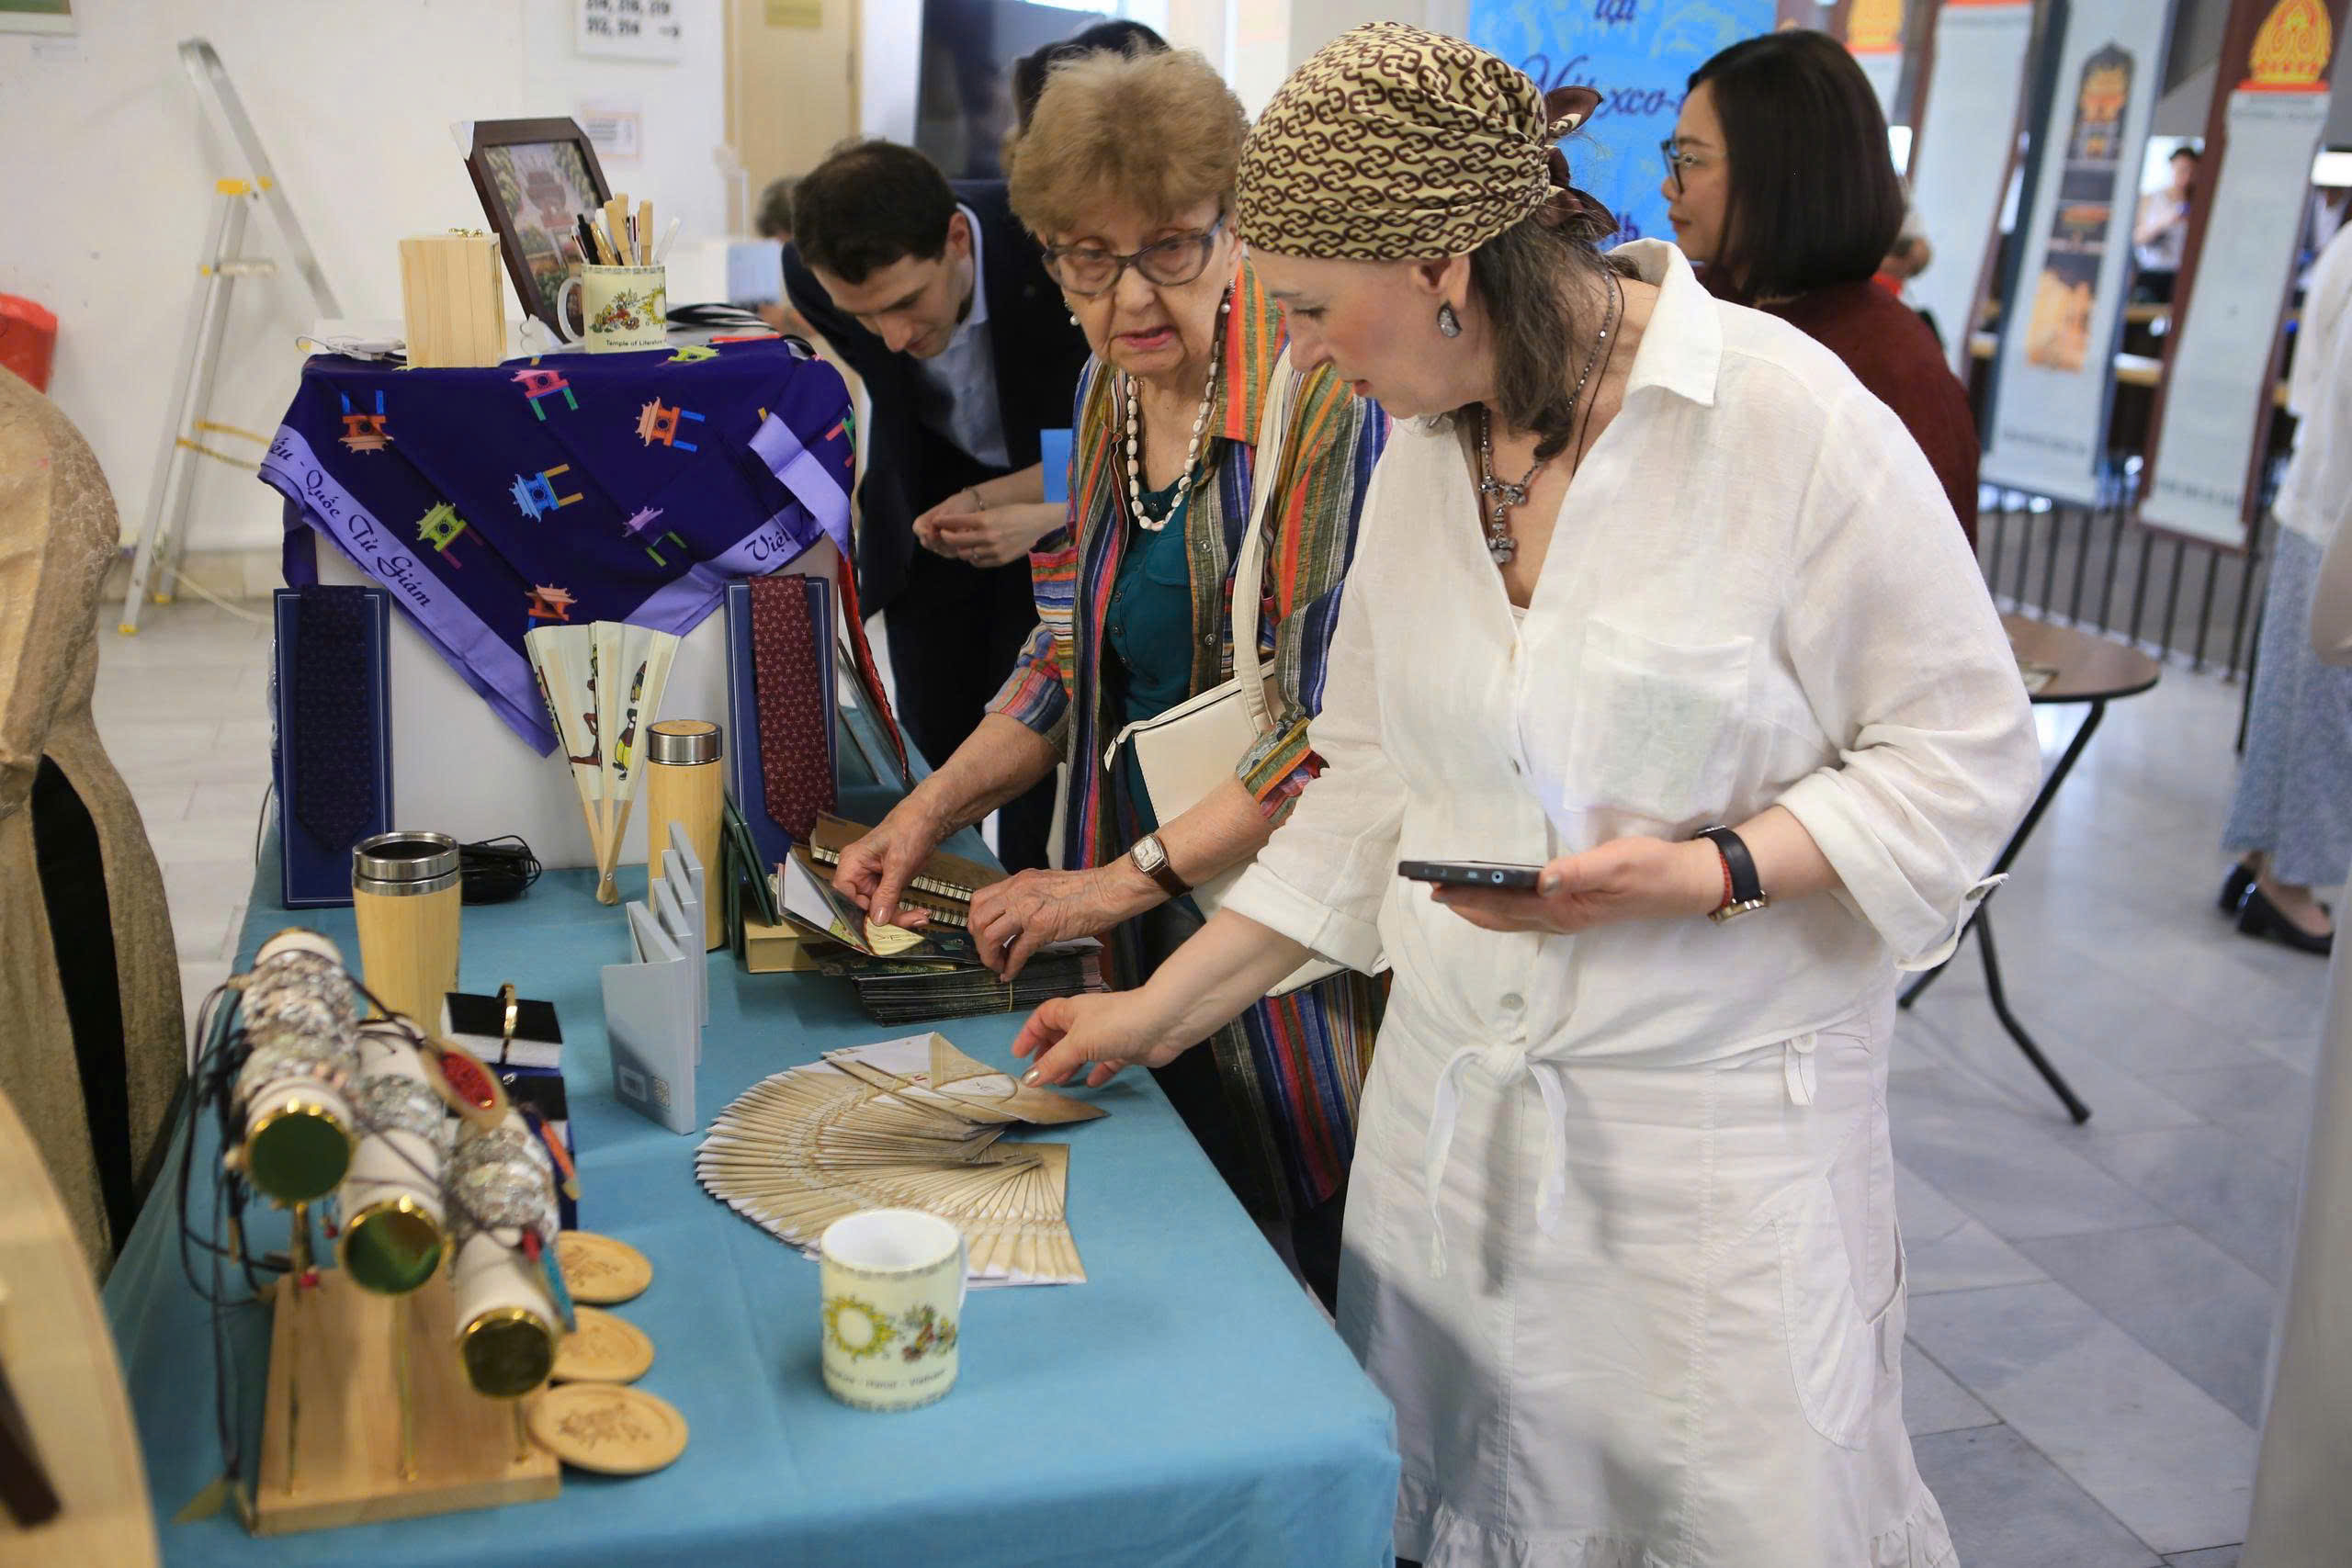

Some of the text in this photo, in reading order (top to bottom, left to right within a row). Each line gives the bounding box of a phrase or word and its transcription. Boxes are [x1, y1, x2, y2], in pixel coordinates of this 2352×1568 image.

[606, 339, 628, 347] Temple
[270, 437, 293, 460] ếu
[306, 469, 340, 519] Quốc
[377, 556, 431, 607] Giám
